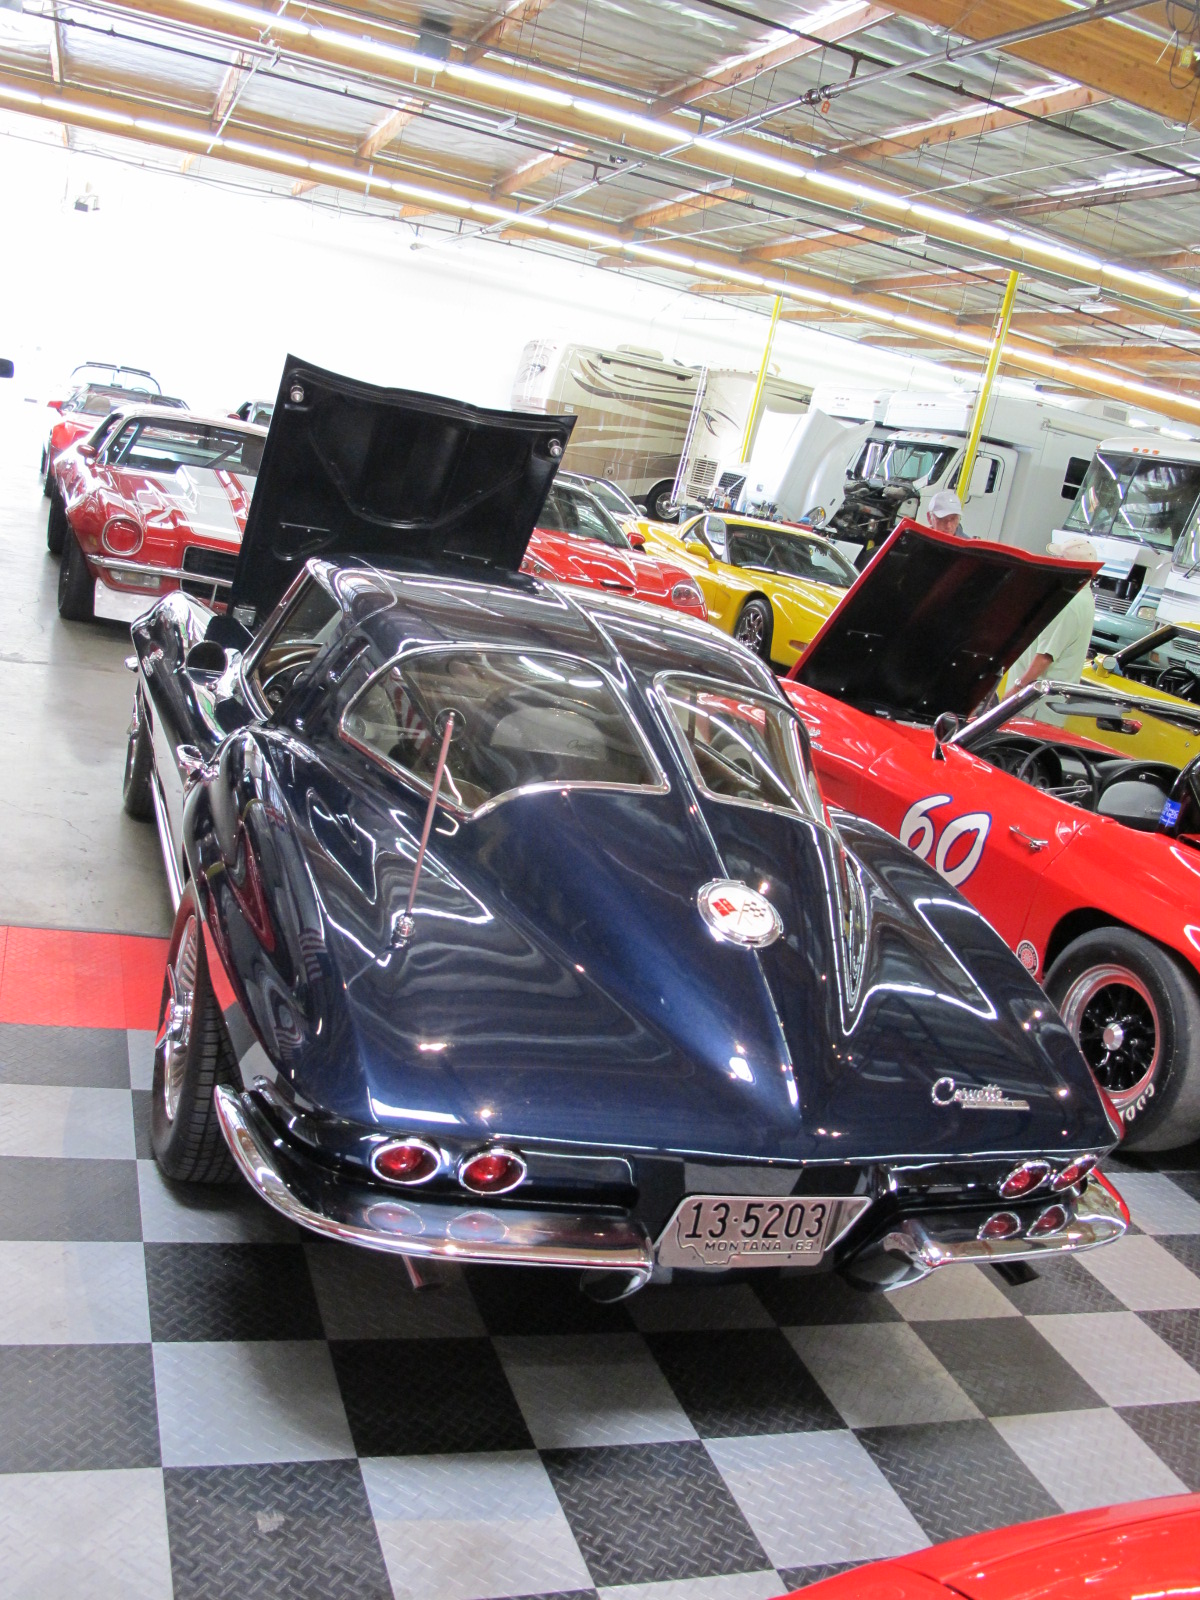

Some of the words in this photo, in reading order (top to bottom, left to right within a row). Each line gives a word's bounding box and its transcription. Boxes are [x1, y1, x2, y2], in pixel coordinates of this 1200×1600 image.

[899, 793, 992, 889] 60
[931, 1076, 1009, 1106] Corvette
[704, 1240, 782, 1251] MONTANA
